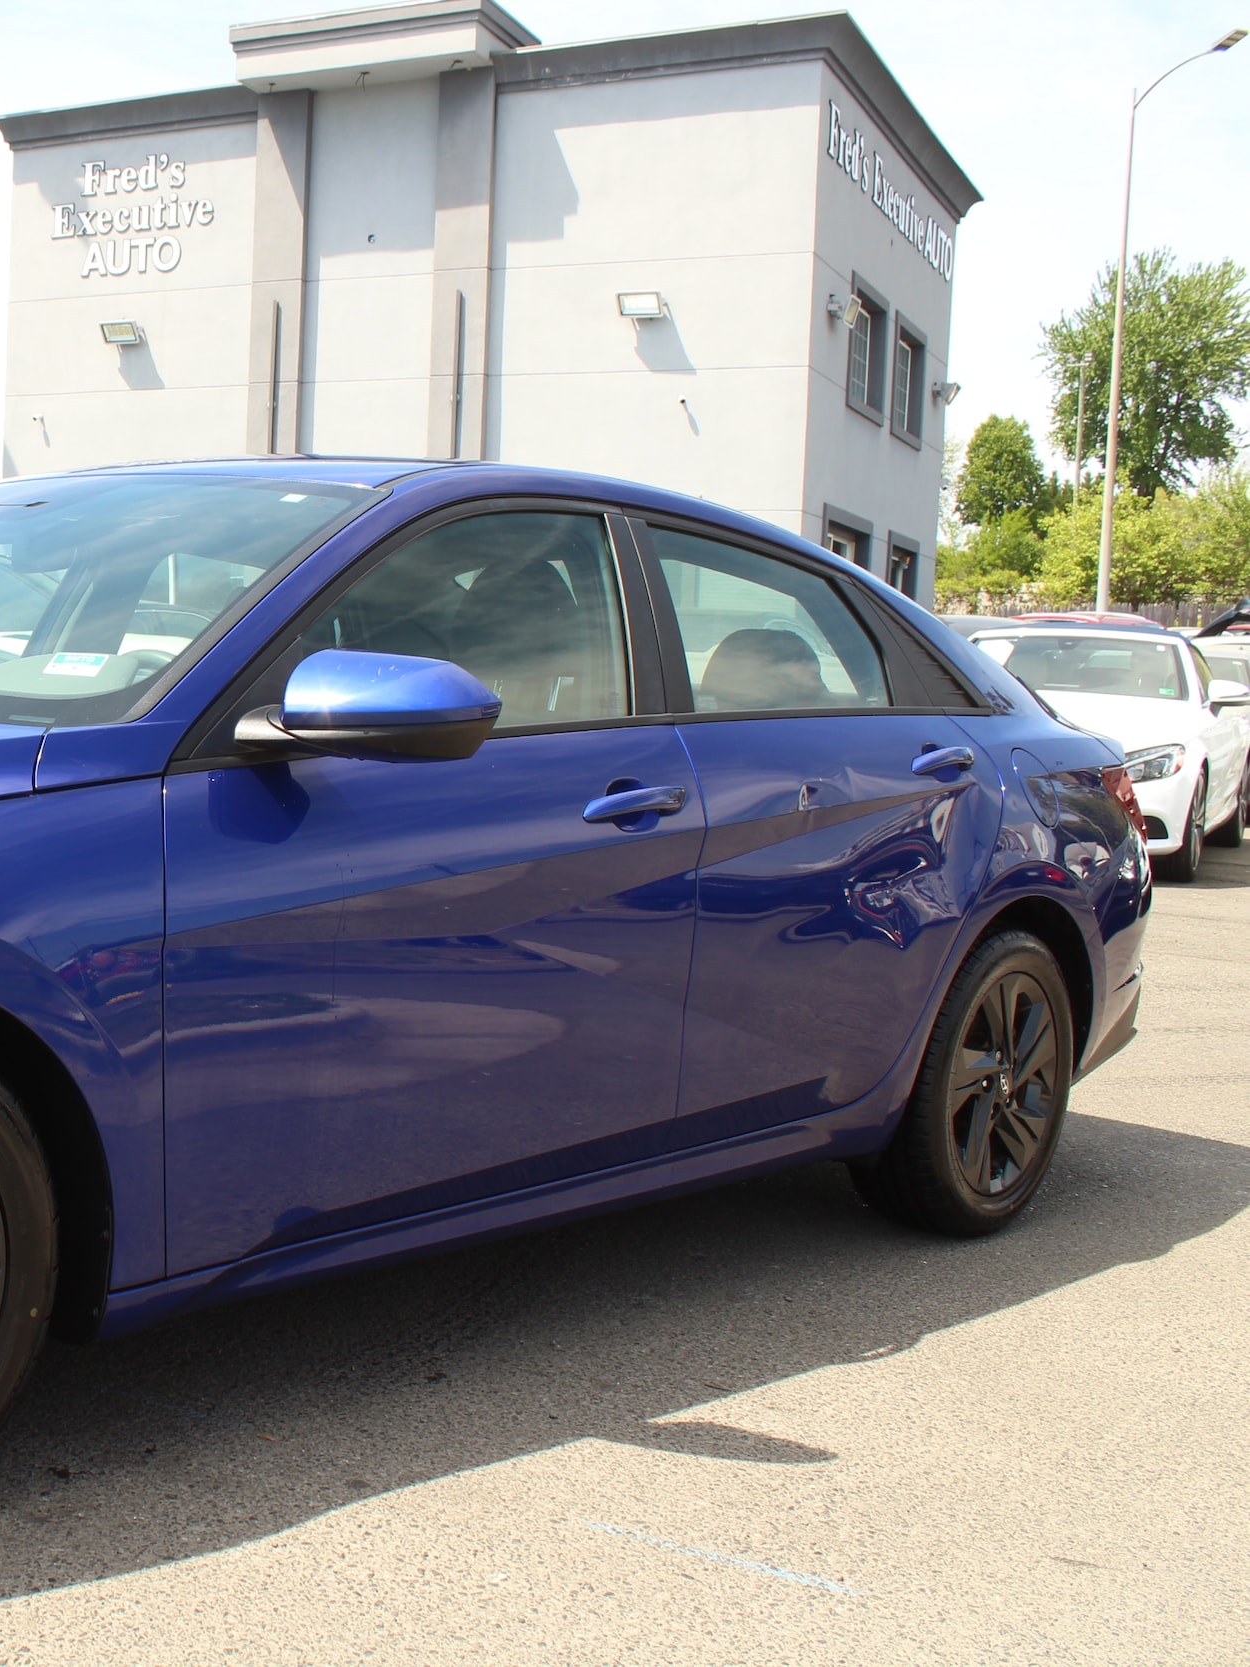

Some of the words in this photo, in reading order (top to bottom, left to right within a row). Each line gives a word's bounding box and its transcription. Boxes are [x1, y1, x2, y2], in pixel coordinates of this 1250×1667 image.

[80, 153, 186, 197] Fred's
[827, 99, 870, 194] Fred's
[872, 151, 924, 252] Executive
[923, 216, 953, 282] AUTO
[51, 193, 215, 239] Executive
[80, 235, 182, 279] AUTO
